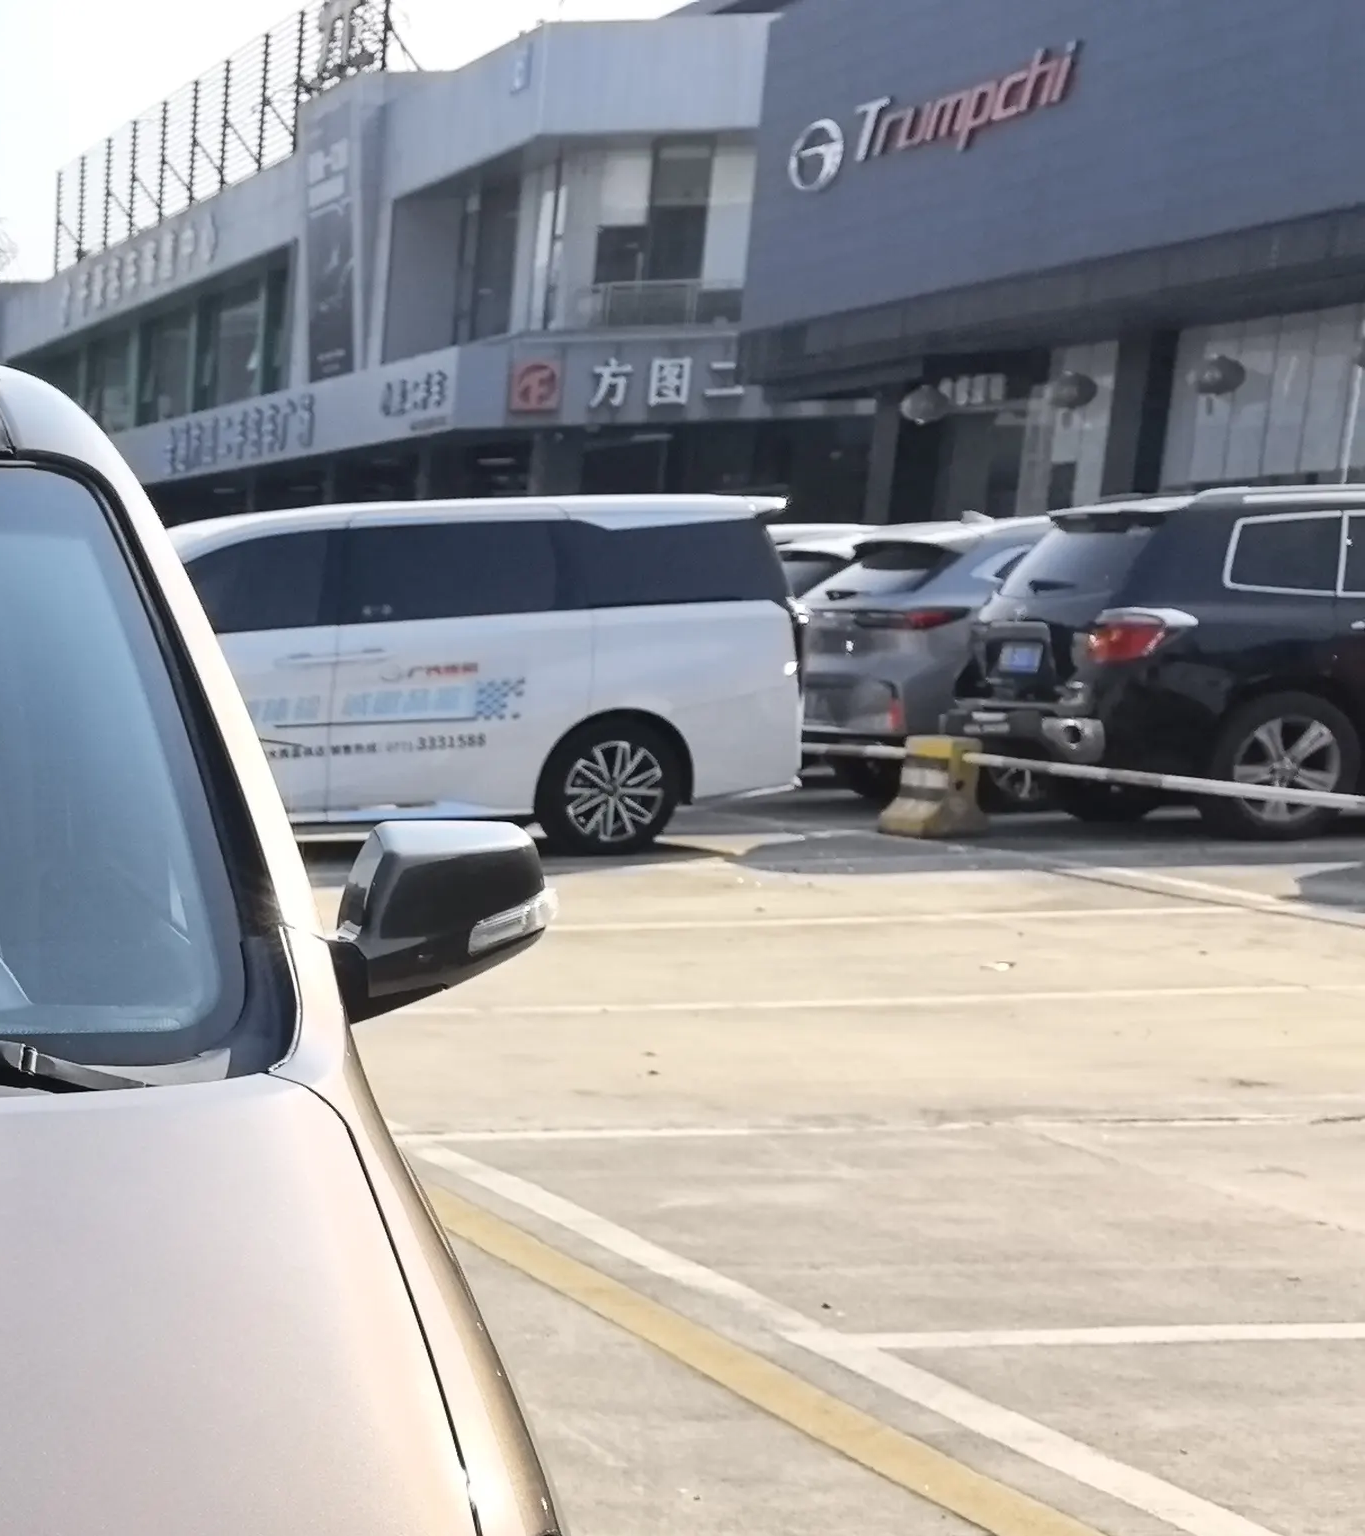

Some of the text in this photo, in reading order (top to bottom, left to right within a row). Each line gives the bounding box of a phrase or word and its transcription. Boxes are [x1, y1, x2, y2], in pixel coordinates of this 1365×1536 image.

[854, 39, 1078, 161] Trumpchi
[588, 356, 745, 407] 方图二
